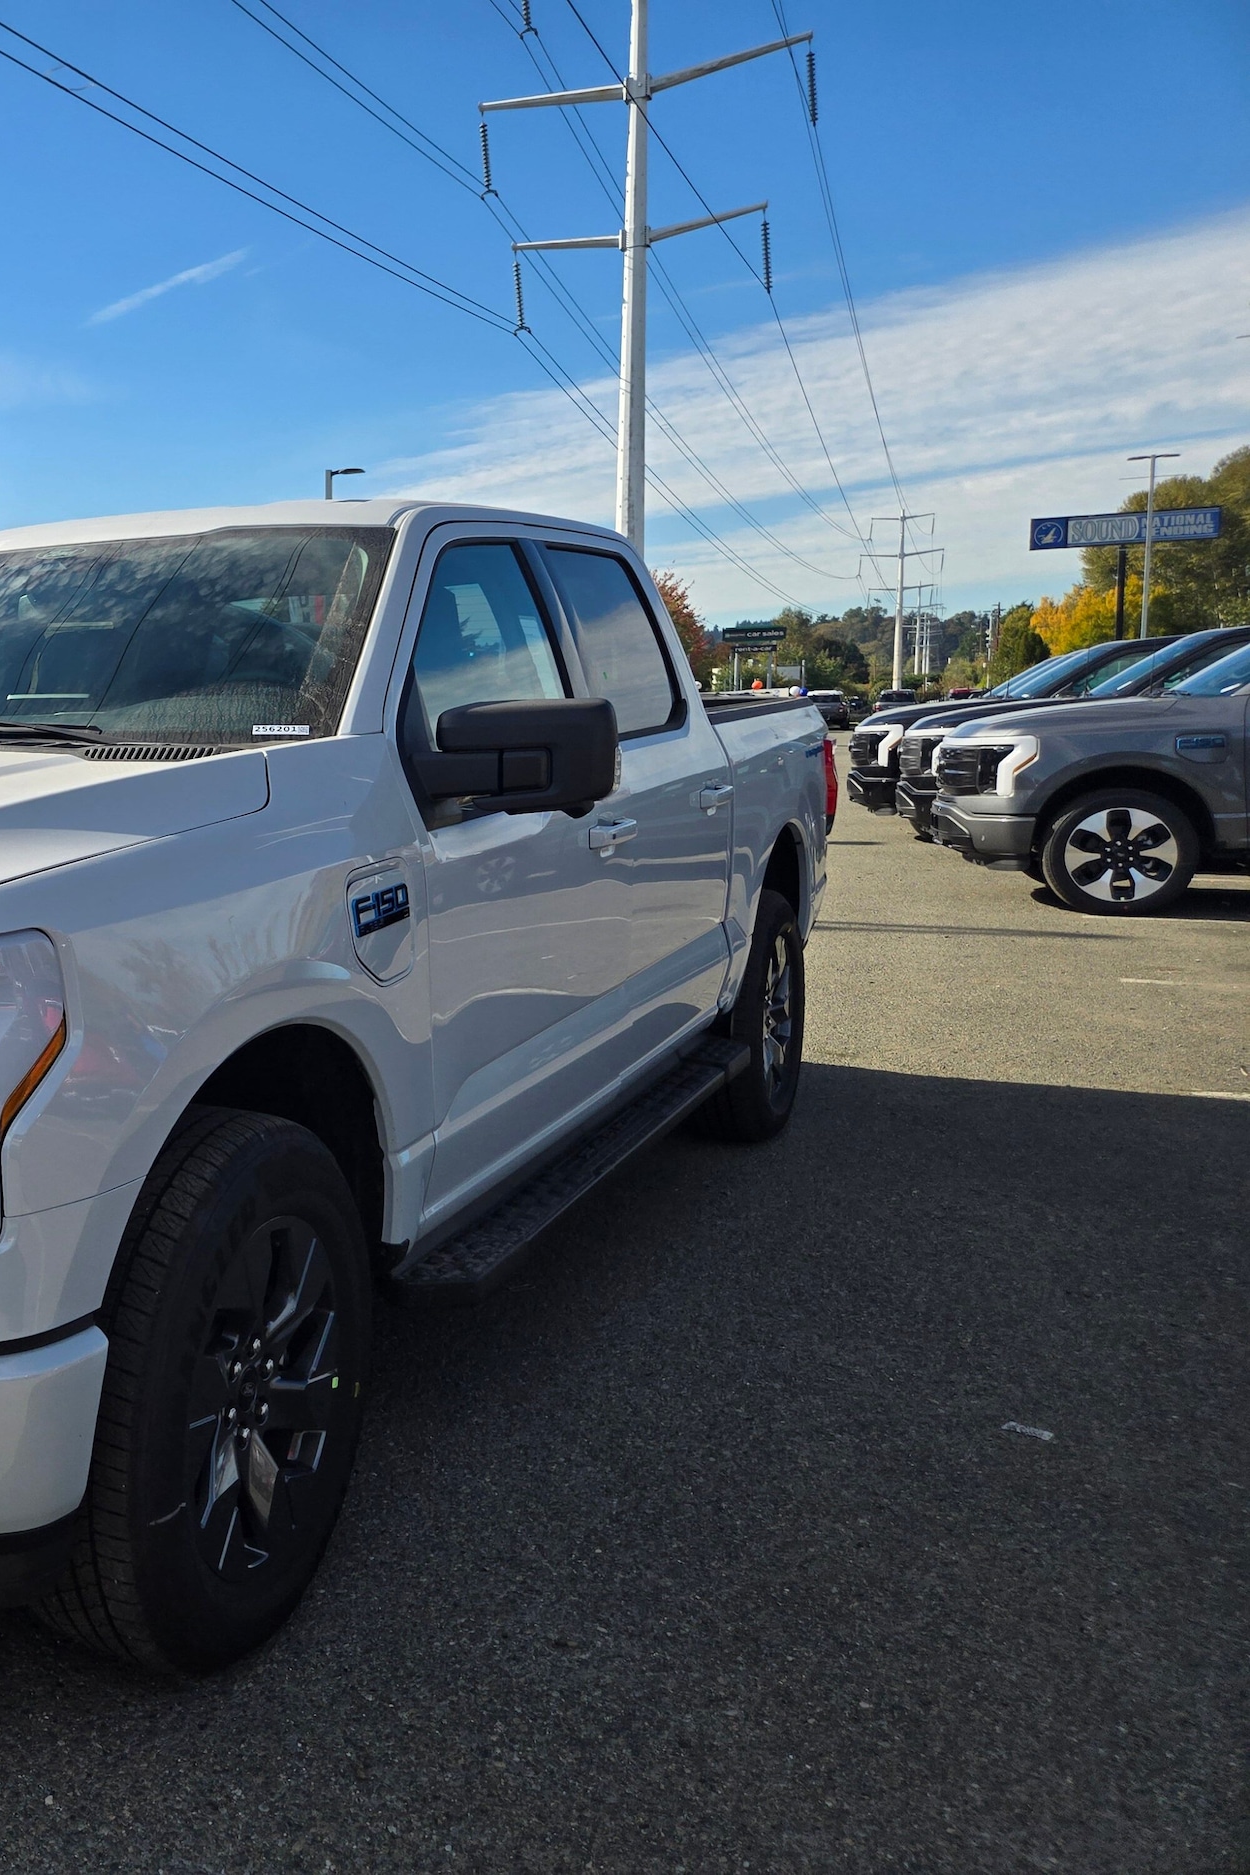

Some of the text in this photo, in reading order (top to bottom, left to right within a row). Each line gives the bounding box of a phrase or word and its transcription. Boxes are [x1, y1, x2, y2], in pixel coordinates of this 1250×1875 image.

[1141, 513, 1213, 528] NATIONAL
[1071, 518, 1138, 543] SOUND
[1141, 524, 1214, 537] LENDING
